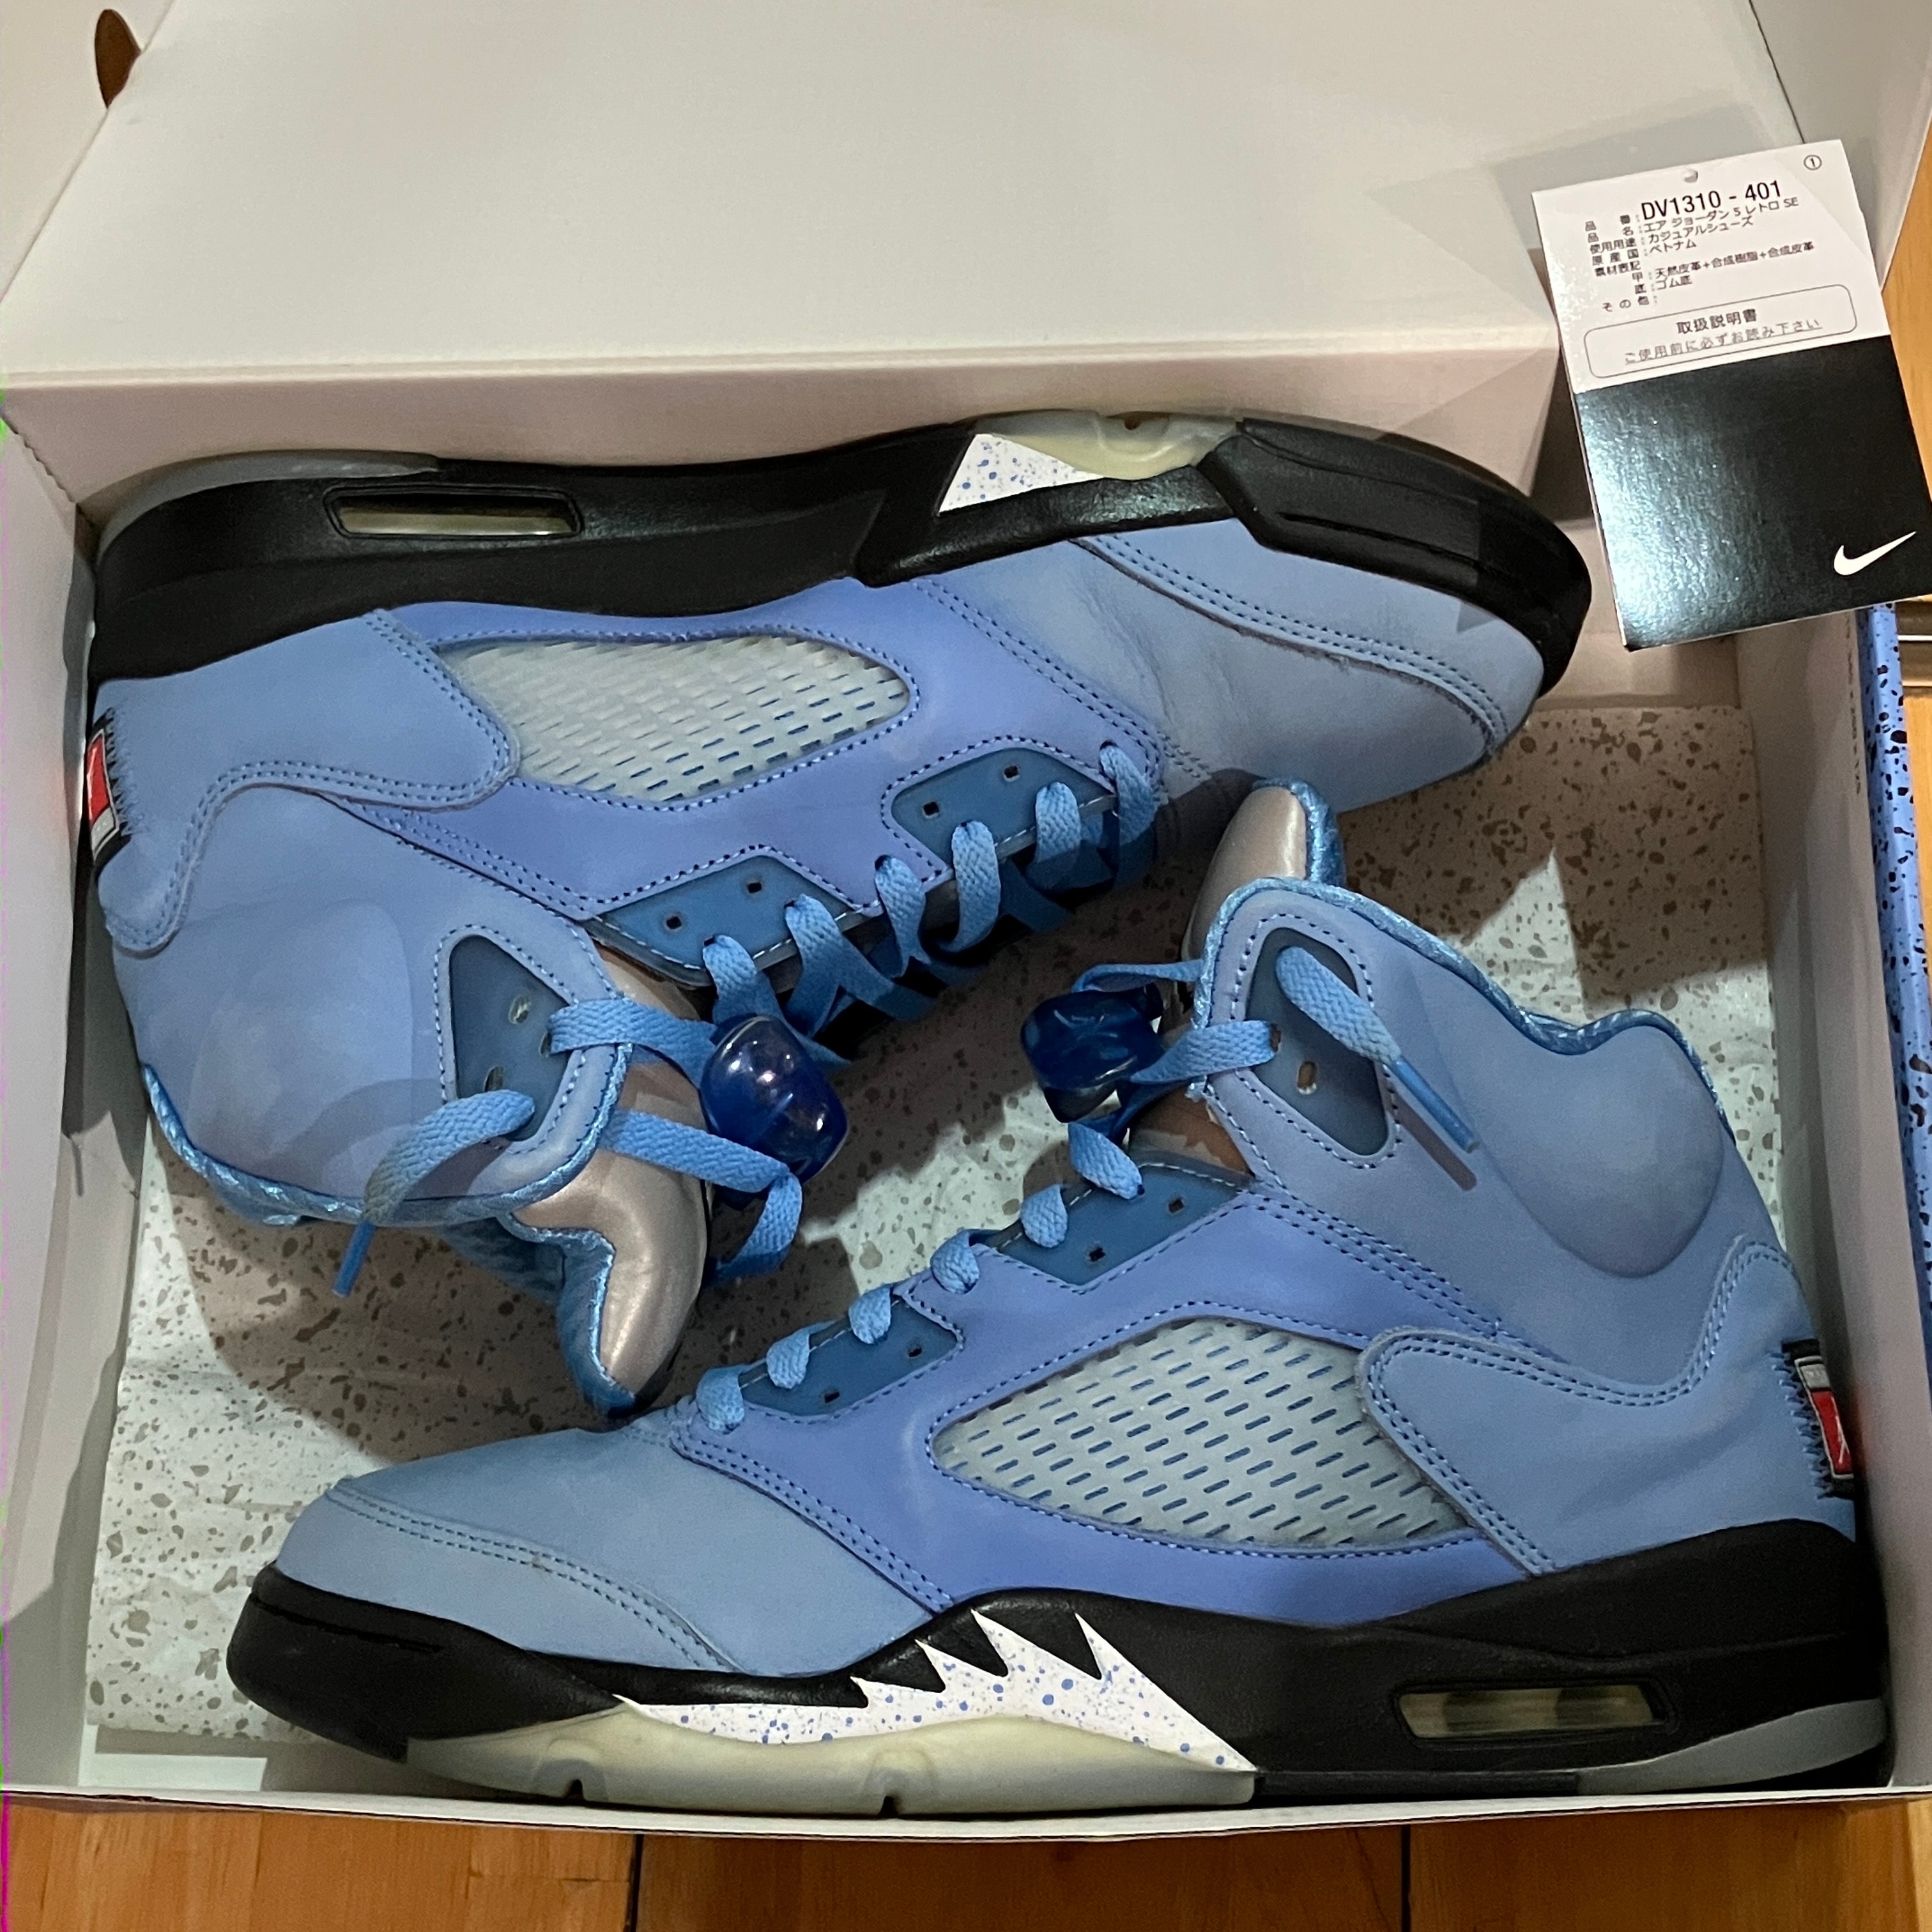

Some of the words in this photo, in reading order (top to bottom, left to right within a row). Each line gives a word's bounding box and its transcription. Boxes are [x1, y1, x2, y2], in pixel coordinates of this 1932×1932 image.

[1783, 197, 1799, 208] SE
[1650, 239, 1697, 253] ベトナム
[1676, 308, 1757, 335] 取扱説明書
